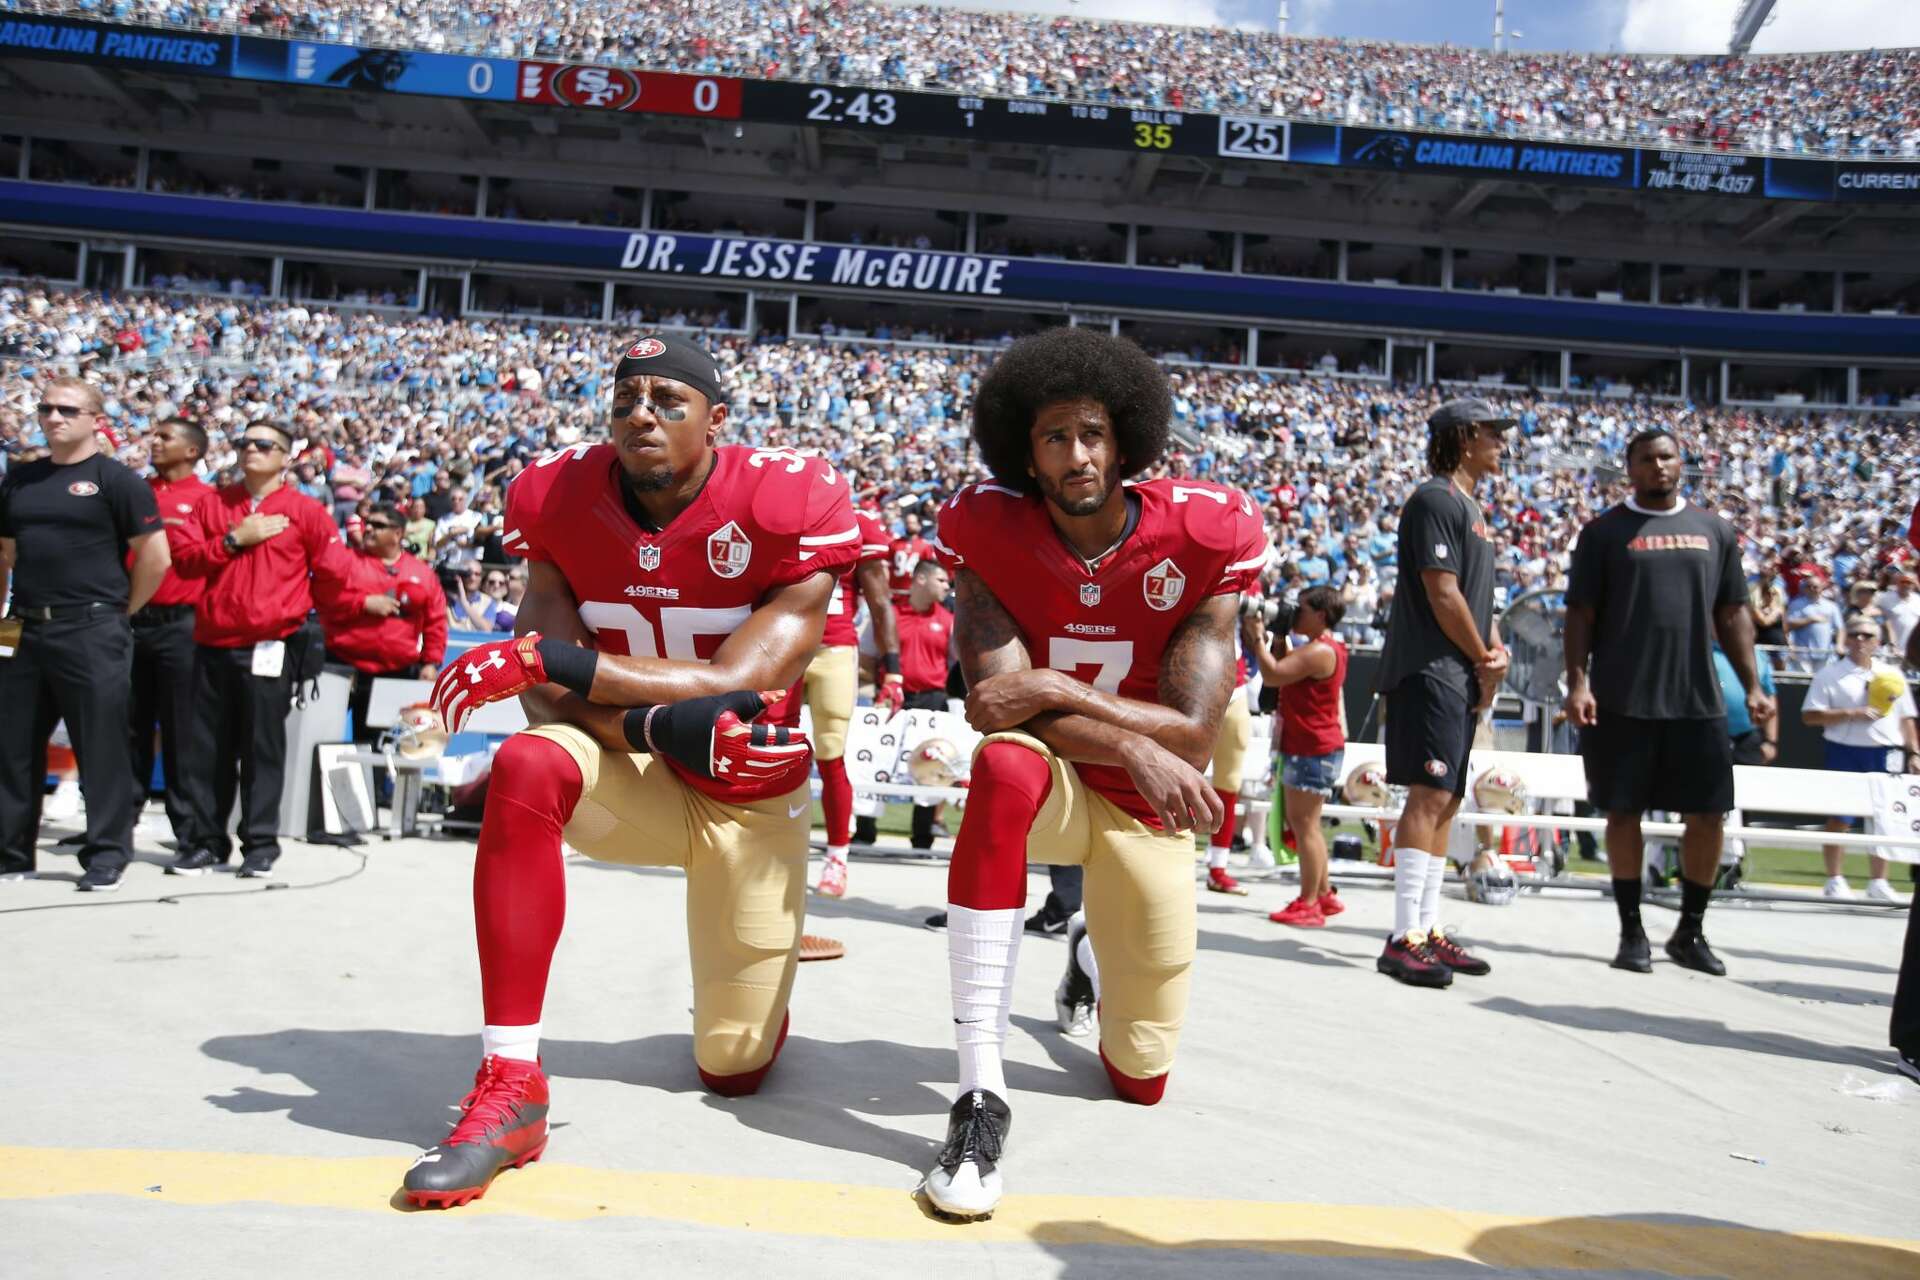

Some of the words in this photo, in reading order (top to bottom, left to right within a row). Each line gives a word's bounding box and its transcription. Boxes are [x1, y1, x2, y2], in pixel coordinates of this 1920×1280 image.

[0, 20, 98, 54] AROLINA
[101, 32, 219, 65] PANTHERS
[467, 61, 494, 95] 0
[693, 79, 720, 112] 0
[806, 88, 897, 126] 2:43
[1007, 101, 1047, 115] DOWN
[964, 112, 975, 127] 1
[1133, 123, 1173, 149] 35
[1229, 121, 1279, 155] 25
[1415, 140, 1514, 170] CAROLINA
[1518, 145, 1624, 178] PANTHERS
[1838, 172, 1920, 189] CURREN
[620, 233, 685, 273] DR.
[700, 238, 821, 282] JESSE
[831, 248, 1009, 296] McGUIRE
[623, 585, 679, 600] 49ERS
[1063, 623, 1116, 635] 49ERS
[1049, 637, 1134, 698] 7
